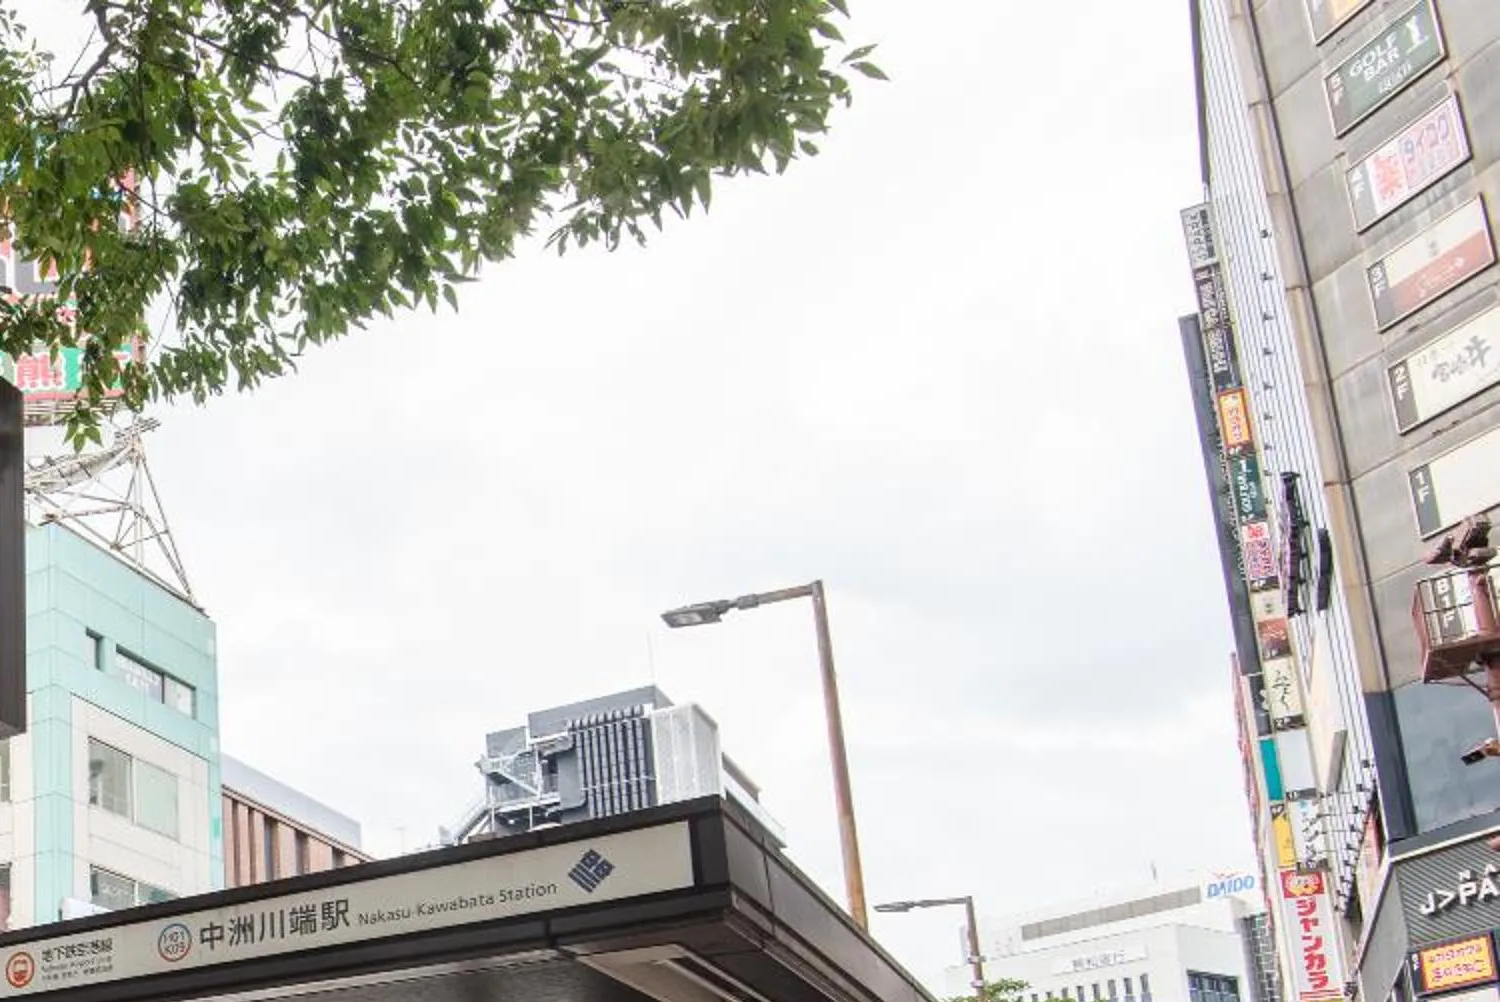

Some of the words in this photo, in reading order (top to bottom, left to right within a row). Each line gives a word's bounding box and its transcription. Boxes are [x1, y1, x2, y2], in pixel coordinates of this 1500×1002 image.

[1350, 33, 1397, 77] GOLF
[1364, 47, 1399, 81] BAR
[1395, 363, 1409, 400] 2F
[1415, 471, 1429, 503] 1F
[499, 881, 558, 904] Station
[1207, 875, 1255, 898] DAIDO
[200, 899, 350, 951] 中洲川端駅
[1296, 898, 1329, 990] ジャンカラ
